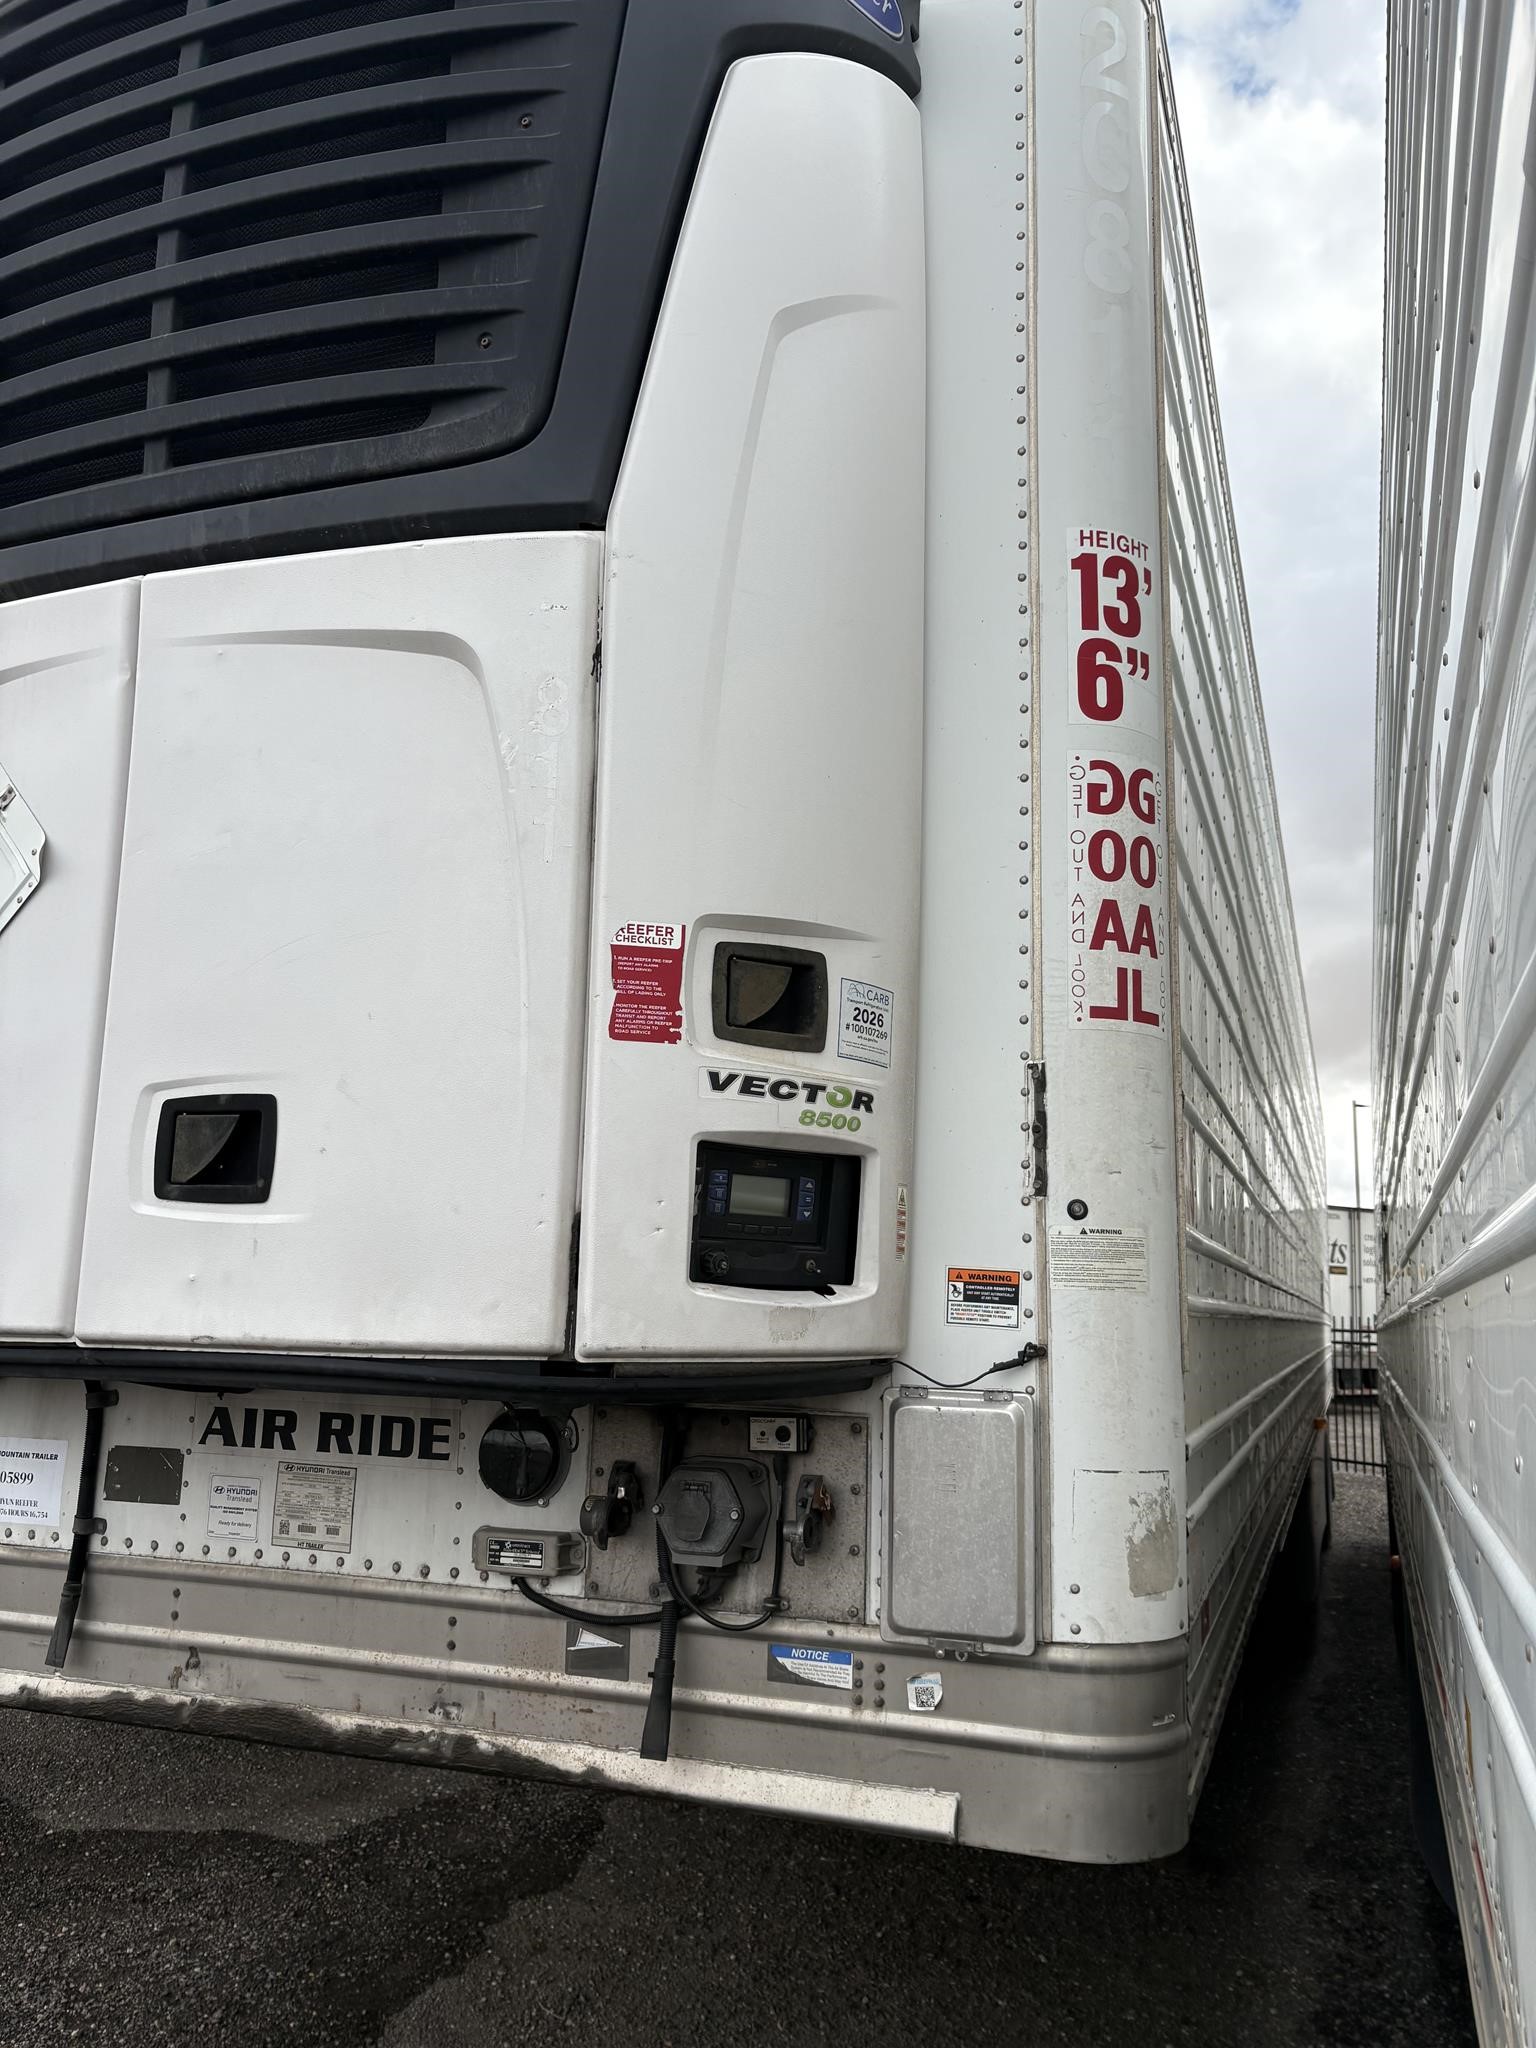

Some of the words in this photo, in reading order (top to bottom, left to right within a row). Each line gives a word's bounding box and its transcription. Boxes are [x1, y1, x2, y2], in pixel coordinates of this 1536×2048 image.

[1080, 530, 1149, 561] HEIGHT
[615, 924, 674, 937] EEFER
[616, 934, 674, 946] CHECKLIST
[866, 990, 890, 1006] CARB
[853, 1007, 884, 1028] 2026
[846, 1023, 888, 1040] #100107269
[708, 1070, 874, 1114] VECTOR
[799, 1109, 862, 1132] 8500
[968, 1273, 1012, 1282] WARNING
[198, 1406, 297, 1451] AIR
[316, 1411, 451, 1461] RIDE
[0, 1450, 30, 1459] OUNTAIN
[31, 1452, 59, 1460] TRAILER
[296, 1466, 325, 1474] HYUNDAI
[326, 1468, 351, 1476] Translead
[226, 1488, 258, 1496] HYUNDAI
[791, 1648, 830, 1661] NOTICE
